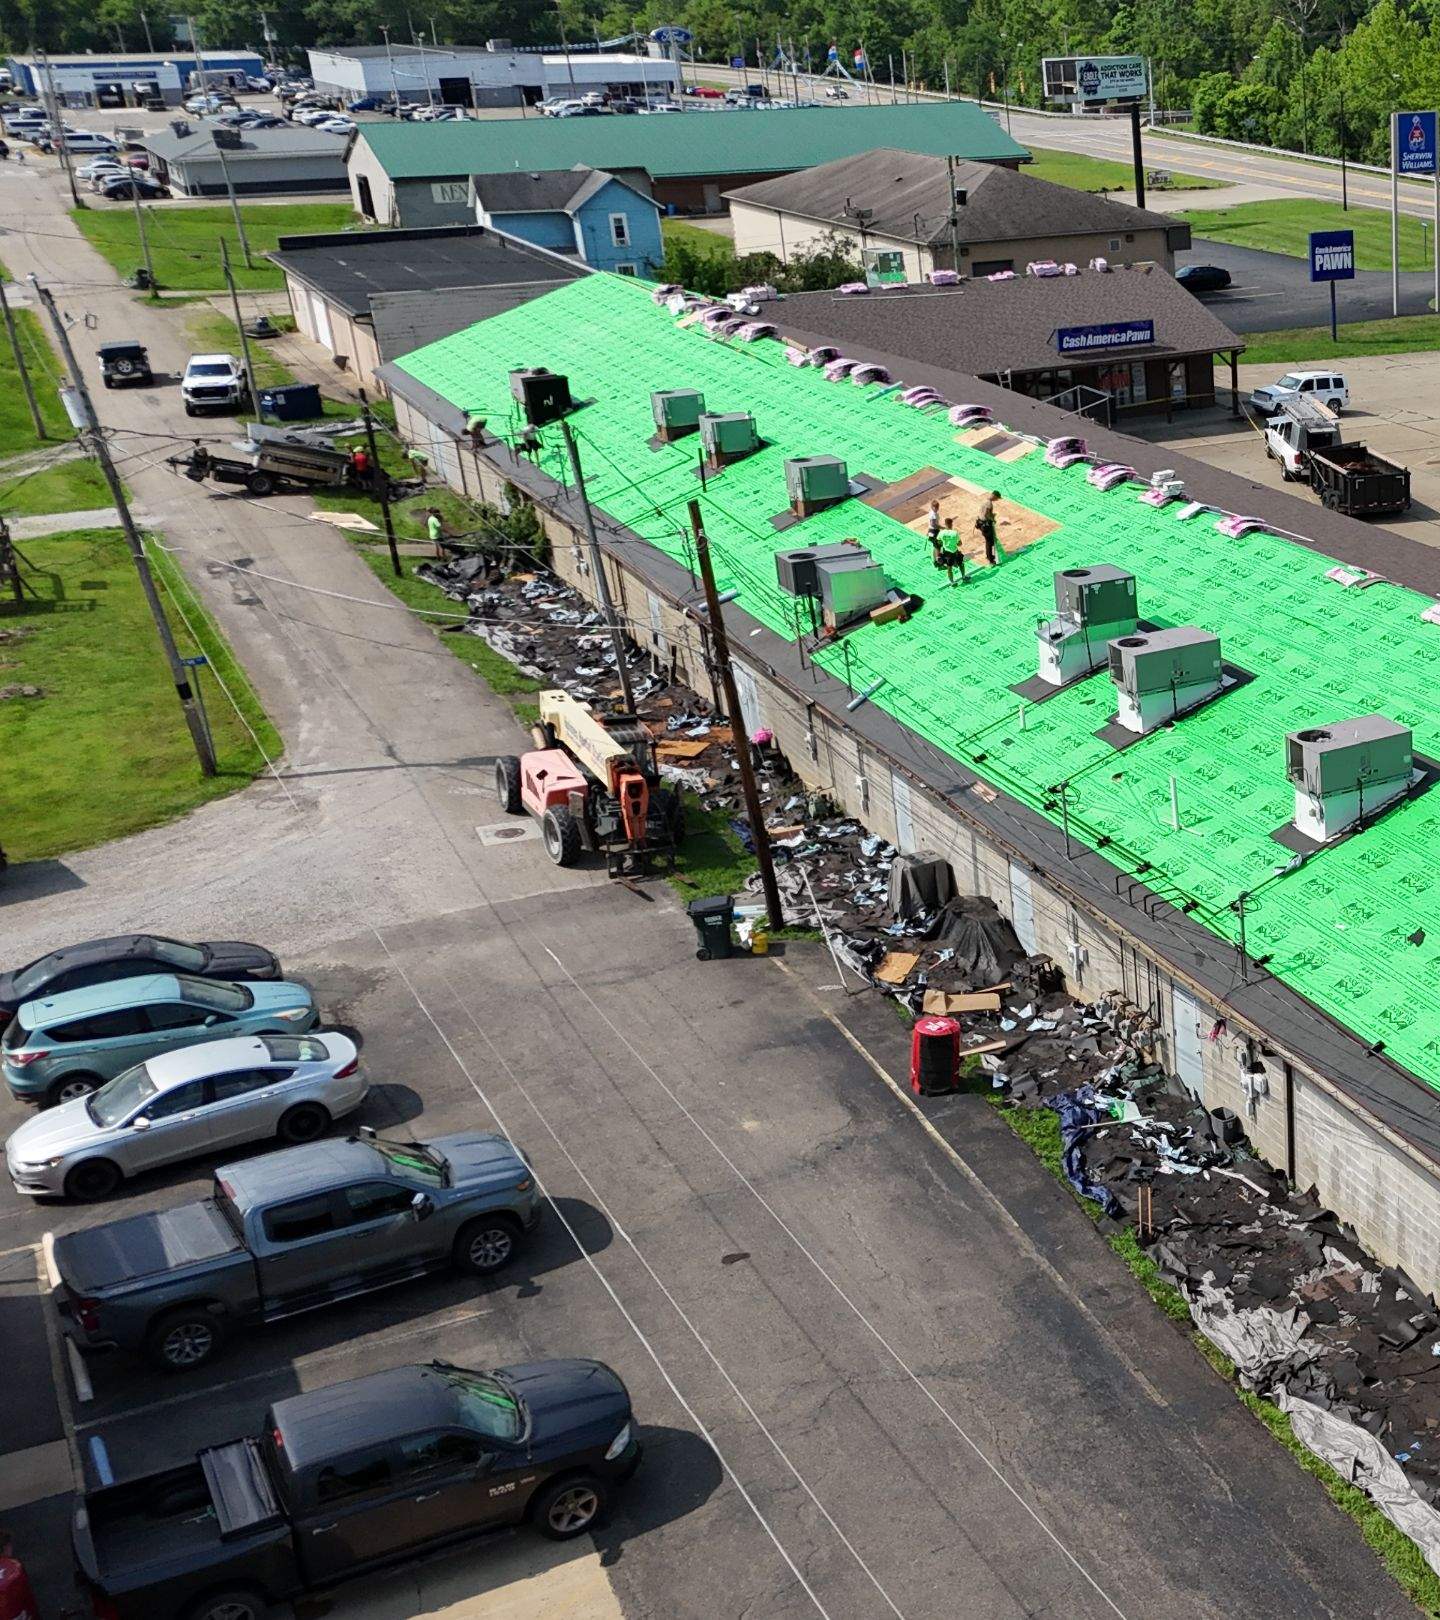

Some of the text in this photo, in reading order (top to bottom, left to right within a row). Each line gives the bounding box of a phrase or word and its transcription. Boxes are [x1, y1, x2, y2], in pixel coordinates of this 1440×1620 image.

[1101, 71, 1117, 79] THAT
[1119, 69, 1142, 78] WORKS
[1402, 152, 1432, 161] SHERWIN
[1315, 253, 1352, 271] PAWN
